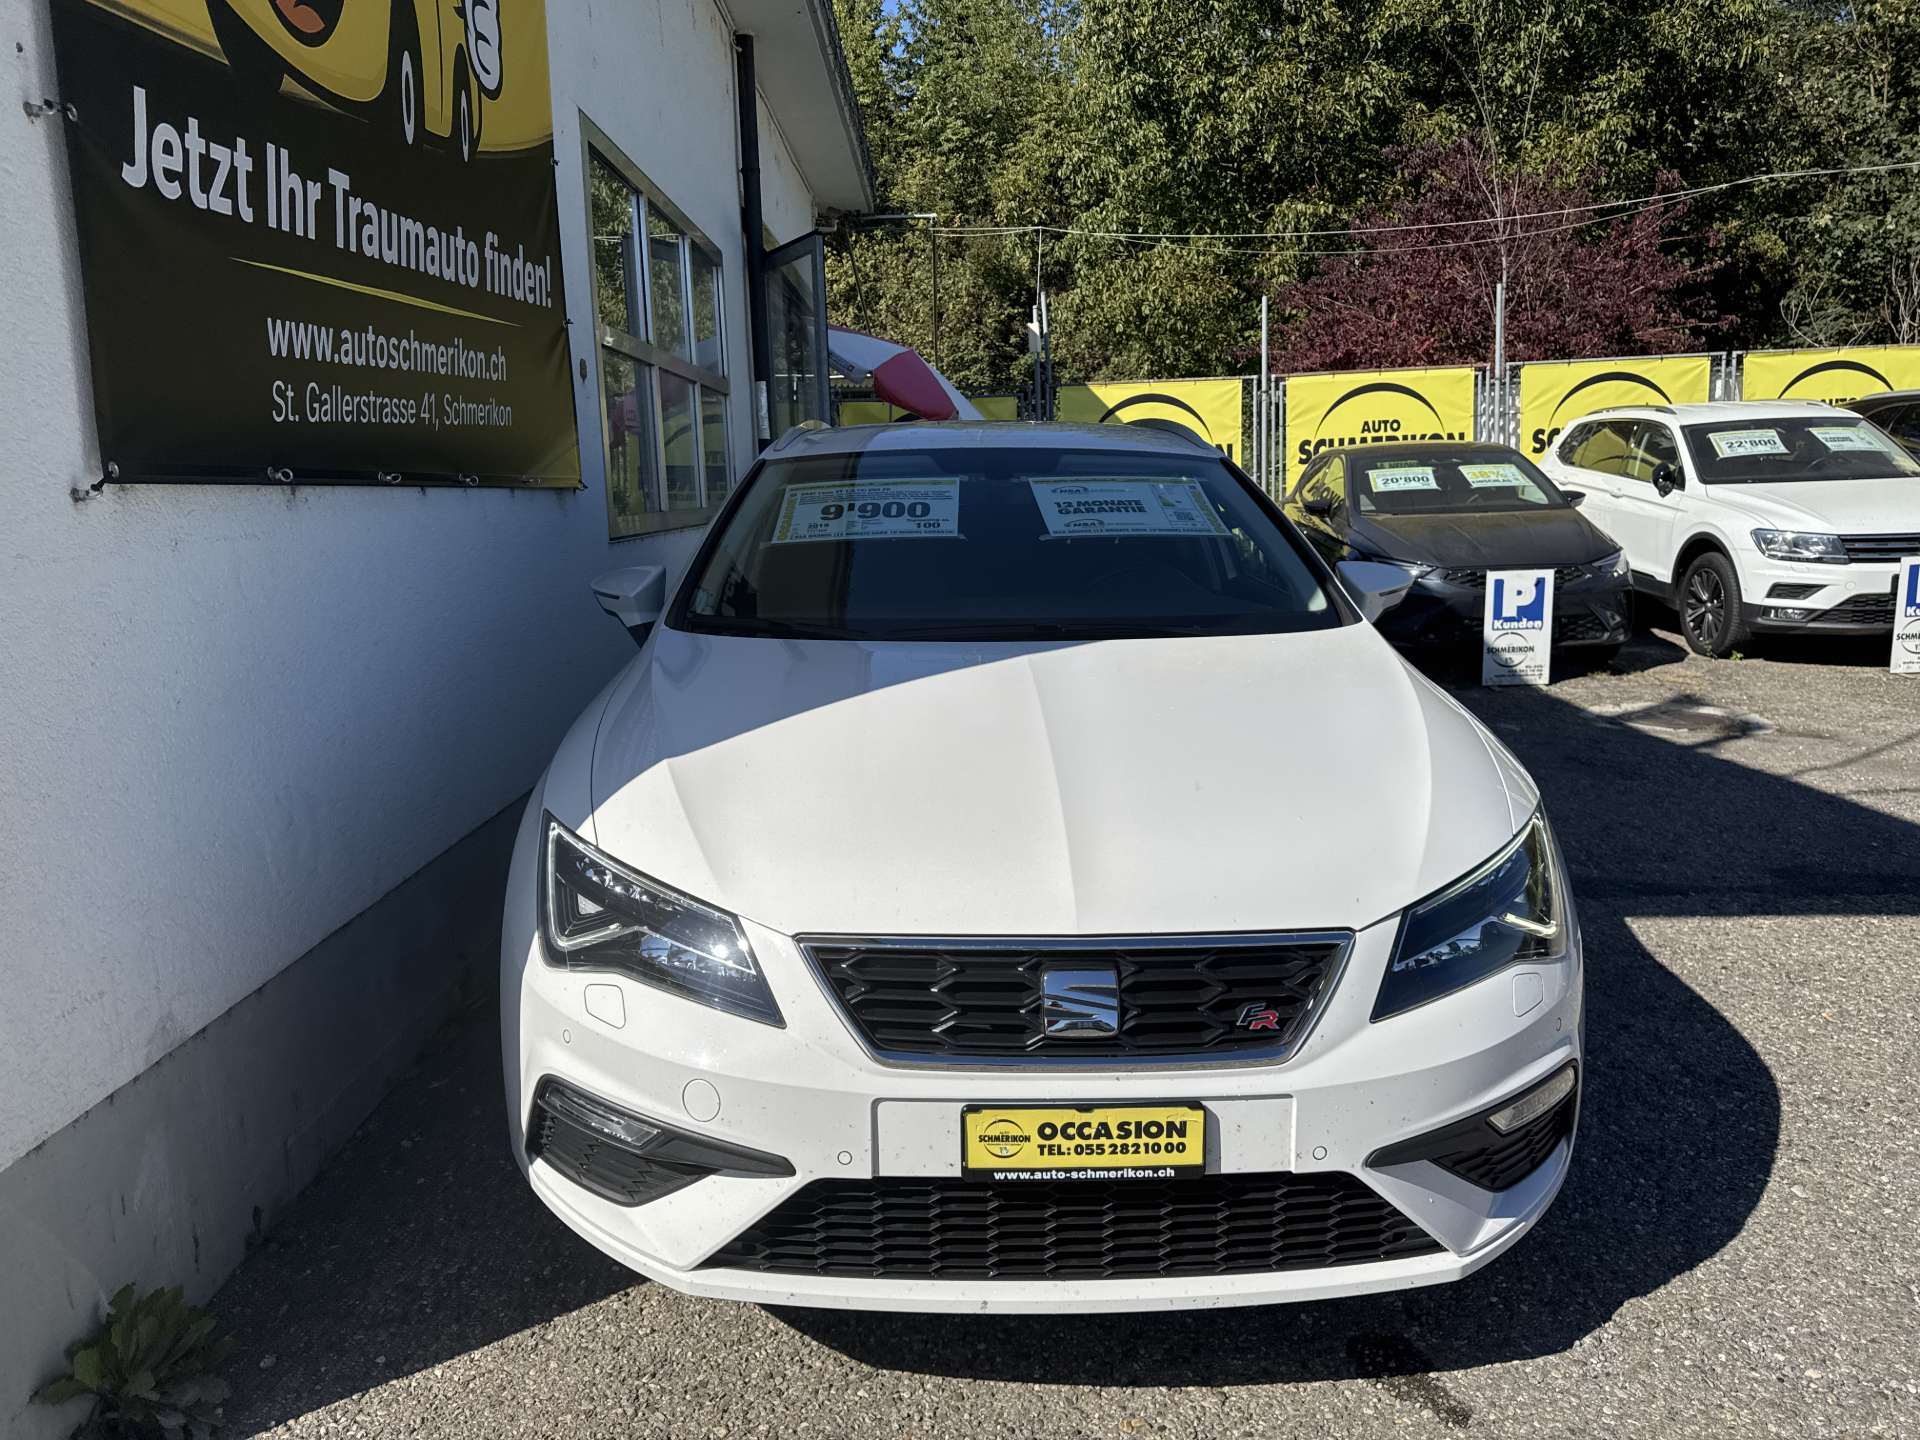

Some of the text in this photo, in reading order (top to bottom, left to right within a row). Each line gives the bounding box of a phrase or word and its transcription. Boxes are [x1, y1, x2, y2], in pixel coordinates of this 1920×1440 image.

[121, 85, 552, 308] Jetzt Ihr Traumauto finden!
[267, 317, 507, 381] www.autoschmerikon.ch
[272, 381, 512, 430] St. Gallerstrasse 41, Schmerikon
[1361, 419, 1401, 434] AUTO
[820, 501, 930, 521] 9'900
[1058, 505, 1148, 515] GARANTIE
[1077, 499, 1144, 508] MONATE
[1501, 577, 1537, 618] P
[1493, 617, 1543, 630] Kunden
[1487, 645, 1535, 654] SCHMERIKON
[1236, 1002, 1280, 1029] FR
[978, 1134, 1031, 1143] SCHMERIKON
[1037, 1120, 1188, 1141] OCCASION
[993, 1167, 1175, 1181] www.auto-schmerikon.ch
